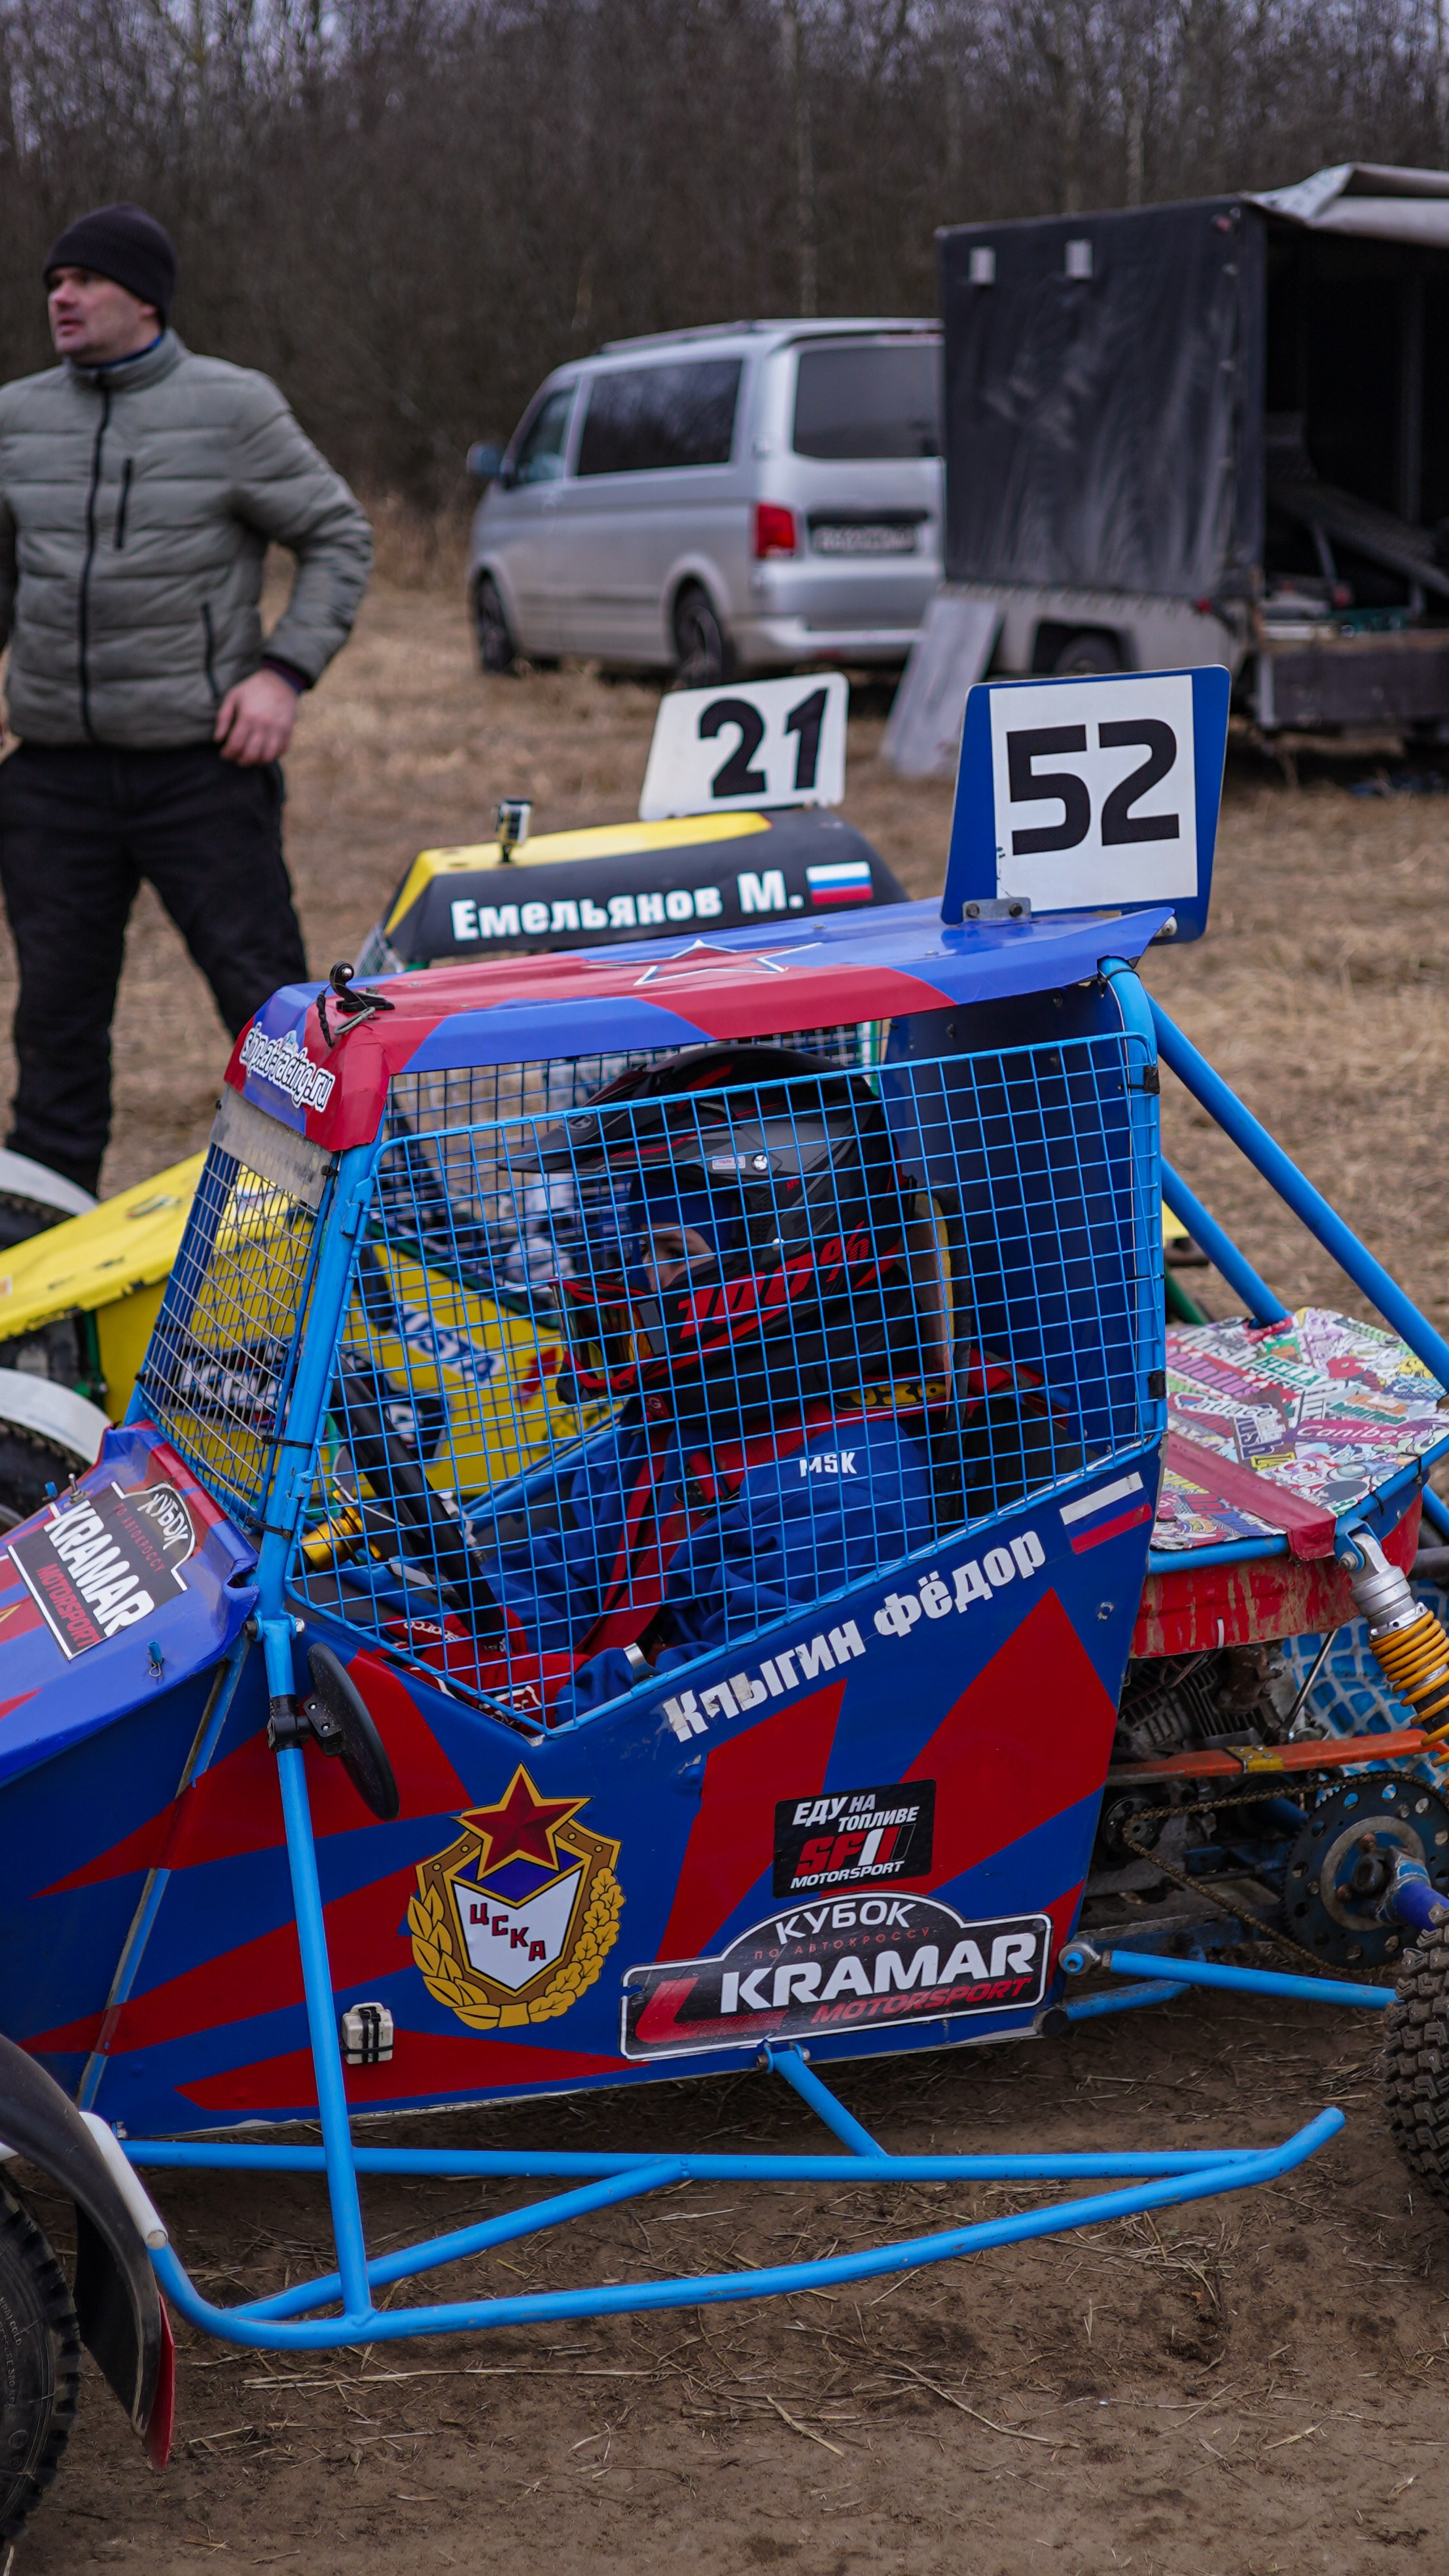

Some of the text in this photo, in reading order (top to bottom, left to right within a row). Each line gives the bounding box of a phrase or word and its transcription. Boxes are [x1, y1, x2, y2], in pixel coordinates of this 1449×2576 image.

[698, 687, 829, 798] 21
[1006, 719, 1180, 856] 52
[450, 869, 804, 941] Емельянов М.
[678, 1221, 869, 1338] 100%
[799, 1451, 857, 1477] MSK
[137, 1493, 188, 1550] КУБОК
[43, 1499, 155, 1637] KRAMAR
[35, 1562, 103, 1648] MOTORSPORT
[662, 1530, 1046, 1743] Клыгин Фёдор
[792, 1793, 876, 1827] ЕДУ НА
[838, 1806, 920, 1833] ТОПЛИВЕ
[790, 1860, 905, 1889] MOTORSPORT
[470, 1902, 546, 1961] ЦСКА
[755, 1927, 930, 1959] ПО АВТОКРОССУ
[775, 1900, 916, 1945] КУБОК
[721, 1933, 1036, 2014] KRAMAR
[810, 1977, 1033, 2024] MOTORSPORT
